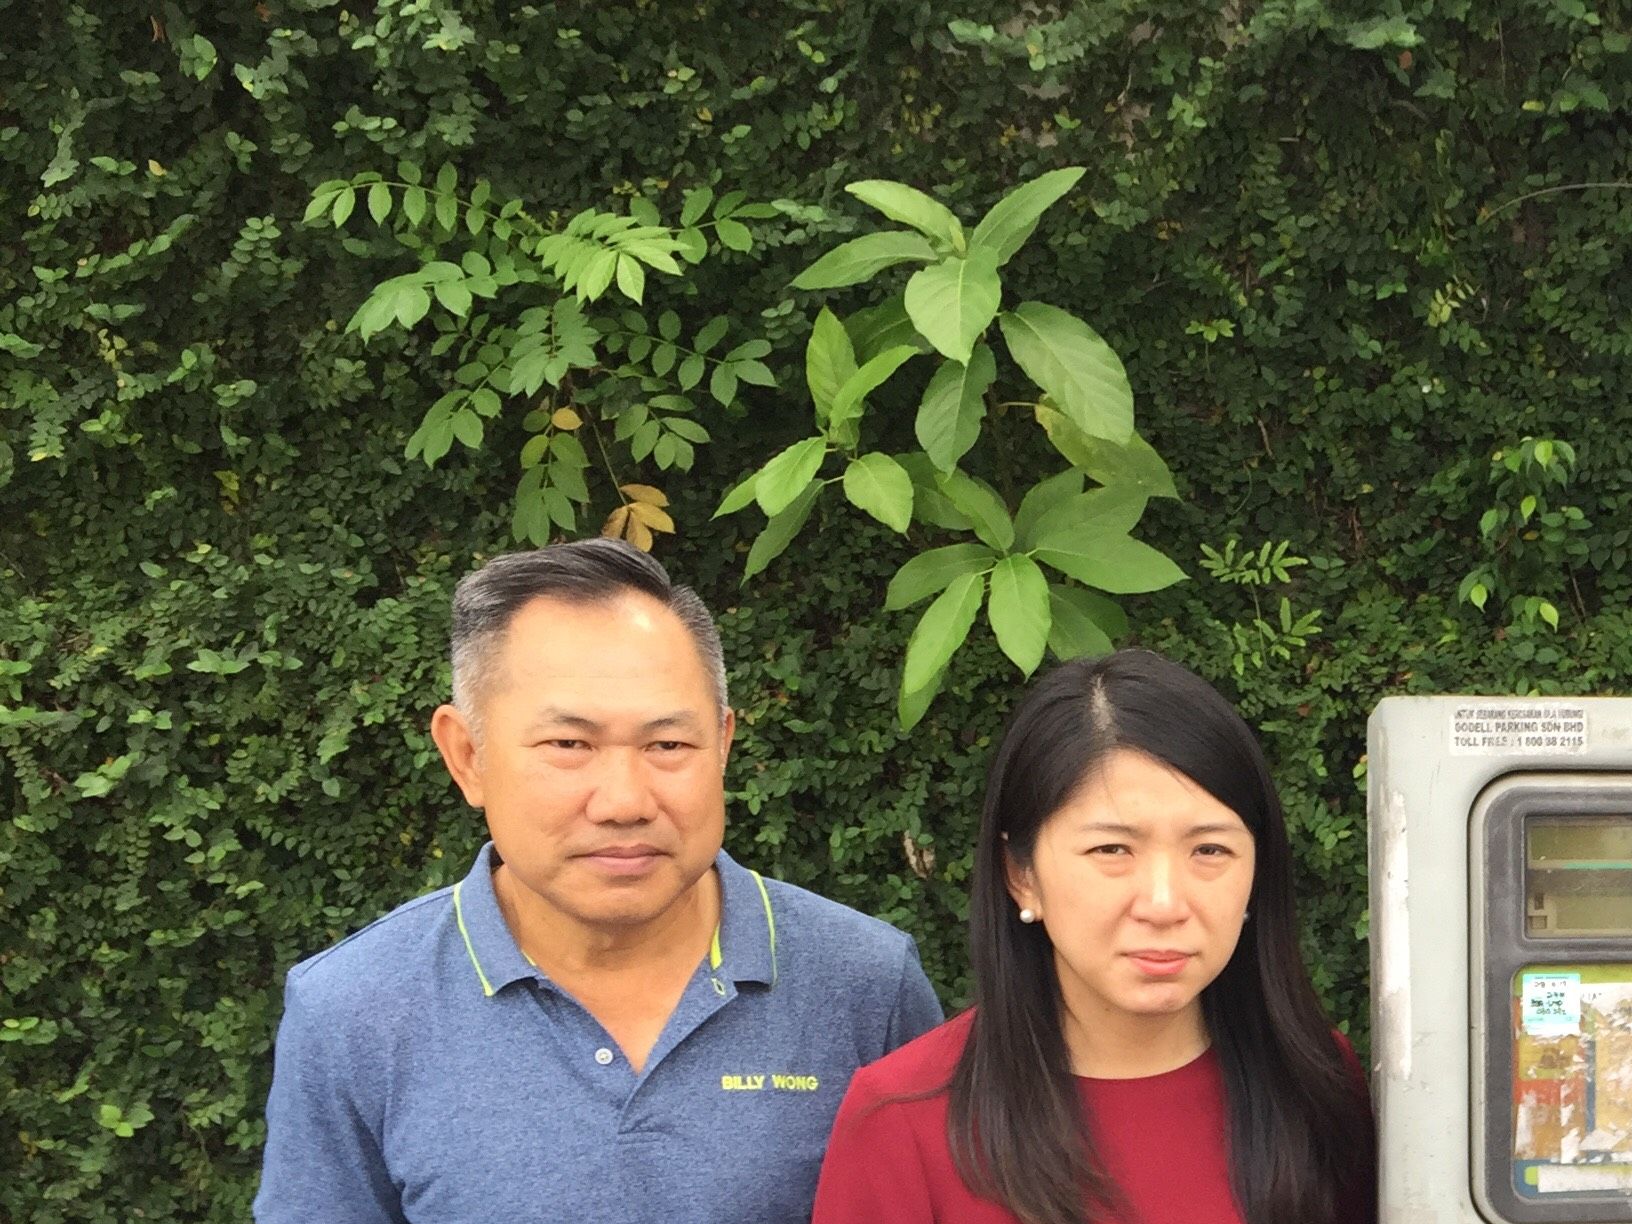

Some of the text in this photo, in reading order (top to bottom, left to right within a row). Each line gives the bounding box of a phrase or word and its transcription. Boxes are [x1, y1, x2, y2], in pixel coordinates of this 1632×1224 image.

[1495, 722, 1539, 733] PARKING
[1454, 736, 1479, 747] TOLL
[721, 1074, 819, 1091] BILLY WONG
